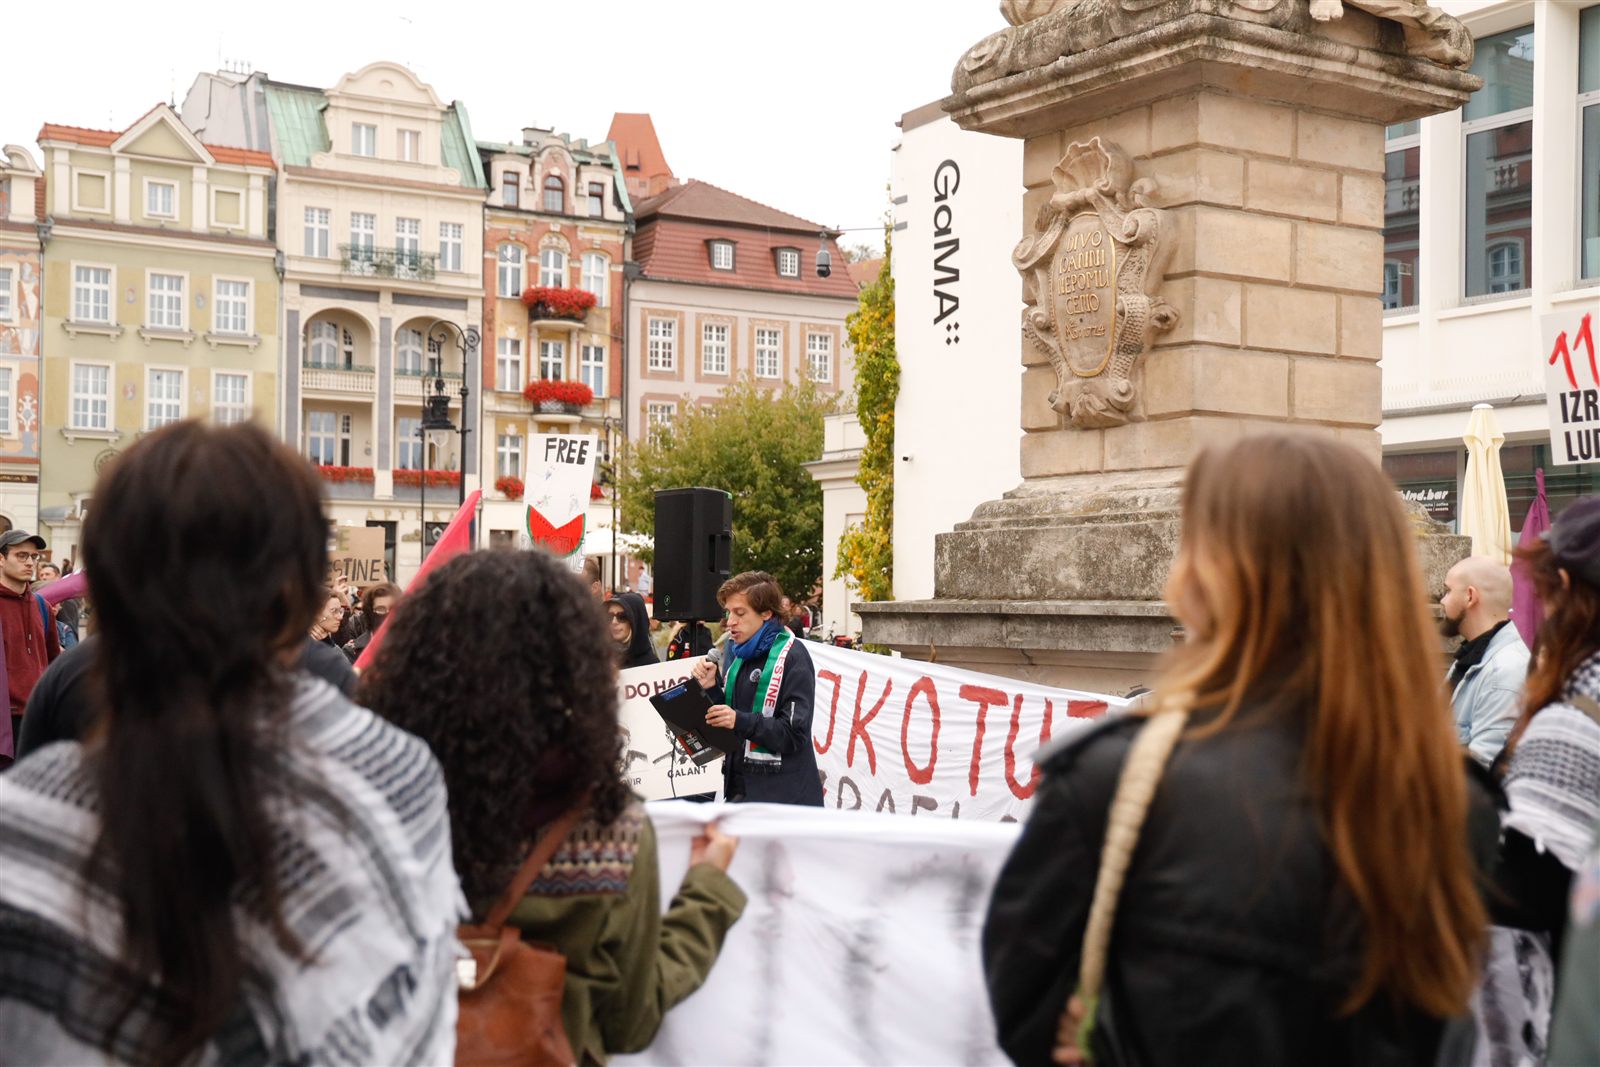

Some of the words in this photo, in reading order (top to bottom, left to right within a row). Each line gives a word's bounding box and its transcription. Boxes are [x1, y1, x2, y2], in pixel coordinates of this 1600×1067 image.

[1066, 230, 1102, 253] DIVO
[1559, 388, 1600, 423] IZR
[544, 437, 590, 465] FREE
[624, 682, 651, 700] DO
[667, 764, 708, 779] GALANT
